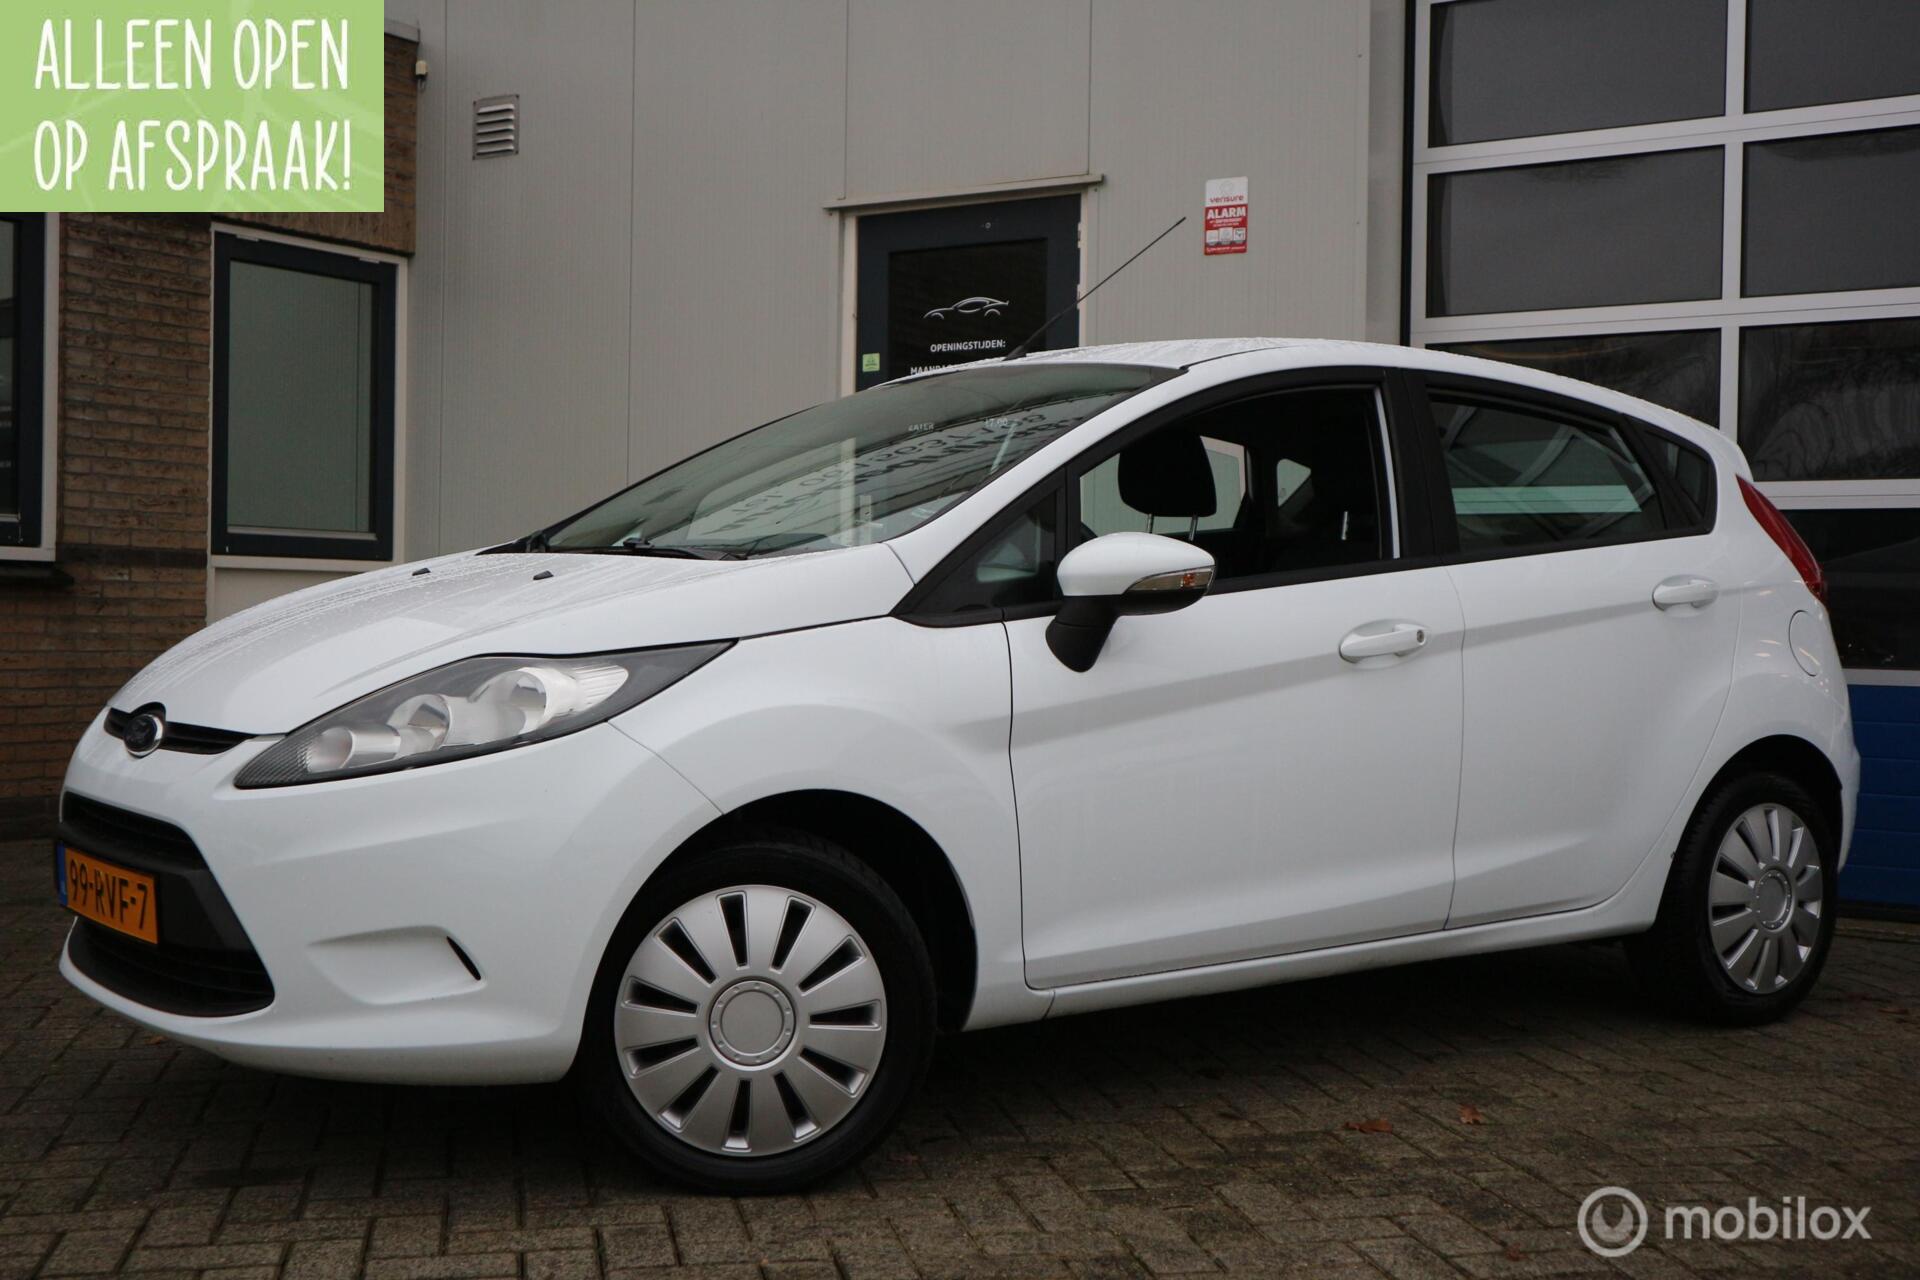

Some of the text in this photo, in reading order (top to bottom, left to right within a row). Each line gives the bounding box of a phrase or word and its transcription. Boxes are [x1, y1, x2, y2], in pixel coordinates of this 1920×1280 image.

[1207, 206, 1246, 219] ALARM
[930, 339, 1006, 353] OPENINGSTIJDEN:
[910, 365, 950, 376] MAAND
[70, 859, 149, 930] 99-RVF-7
